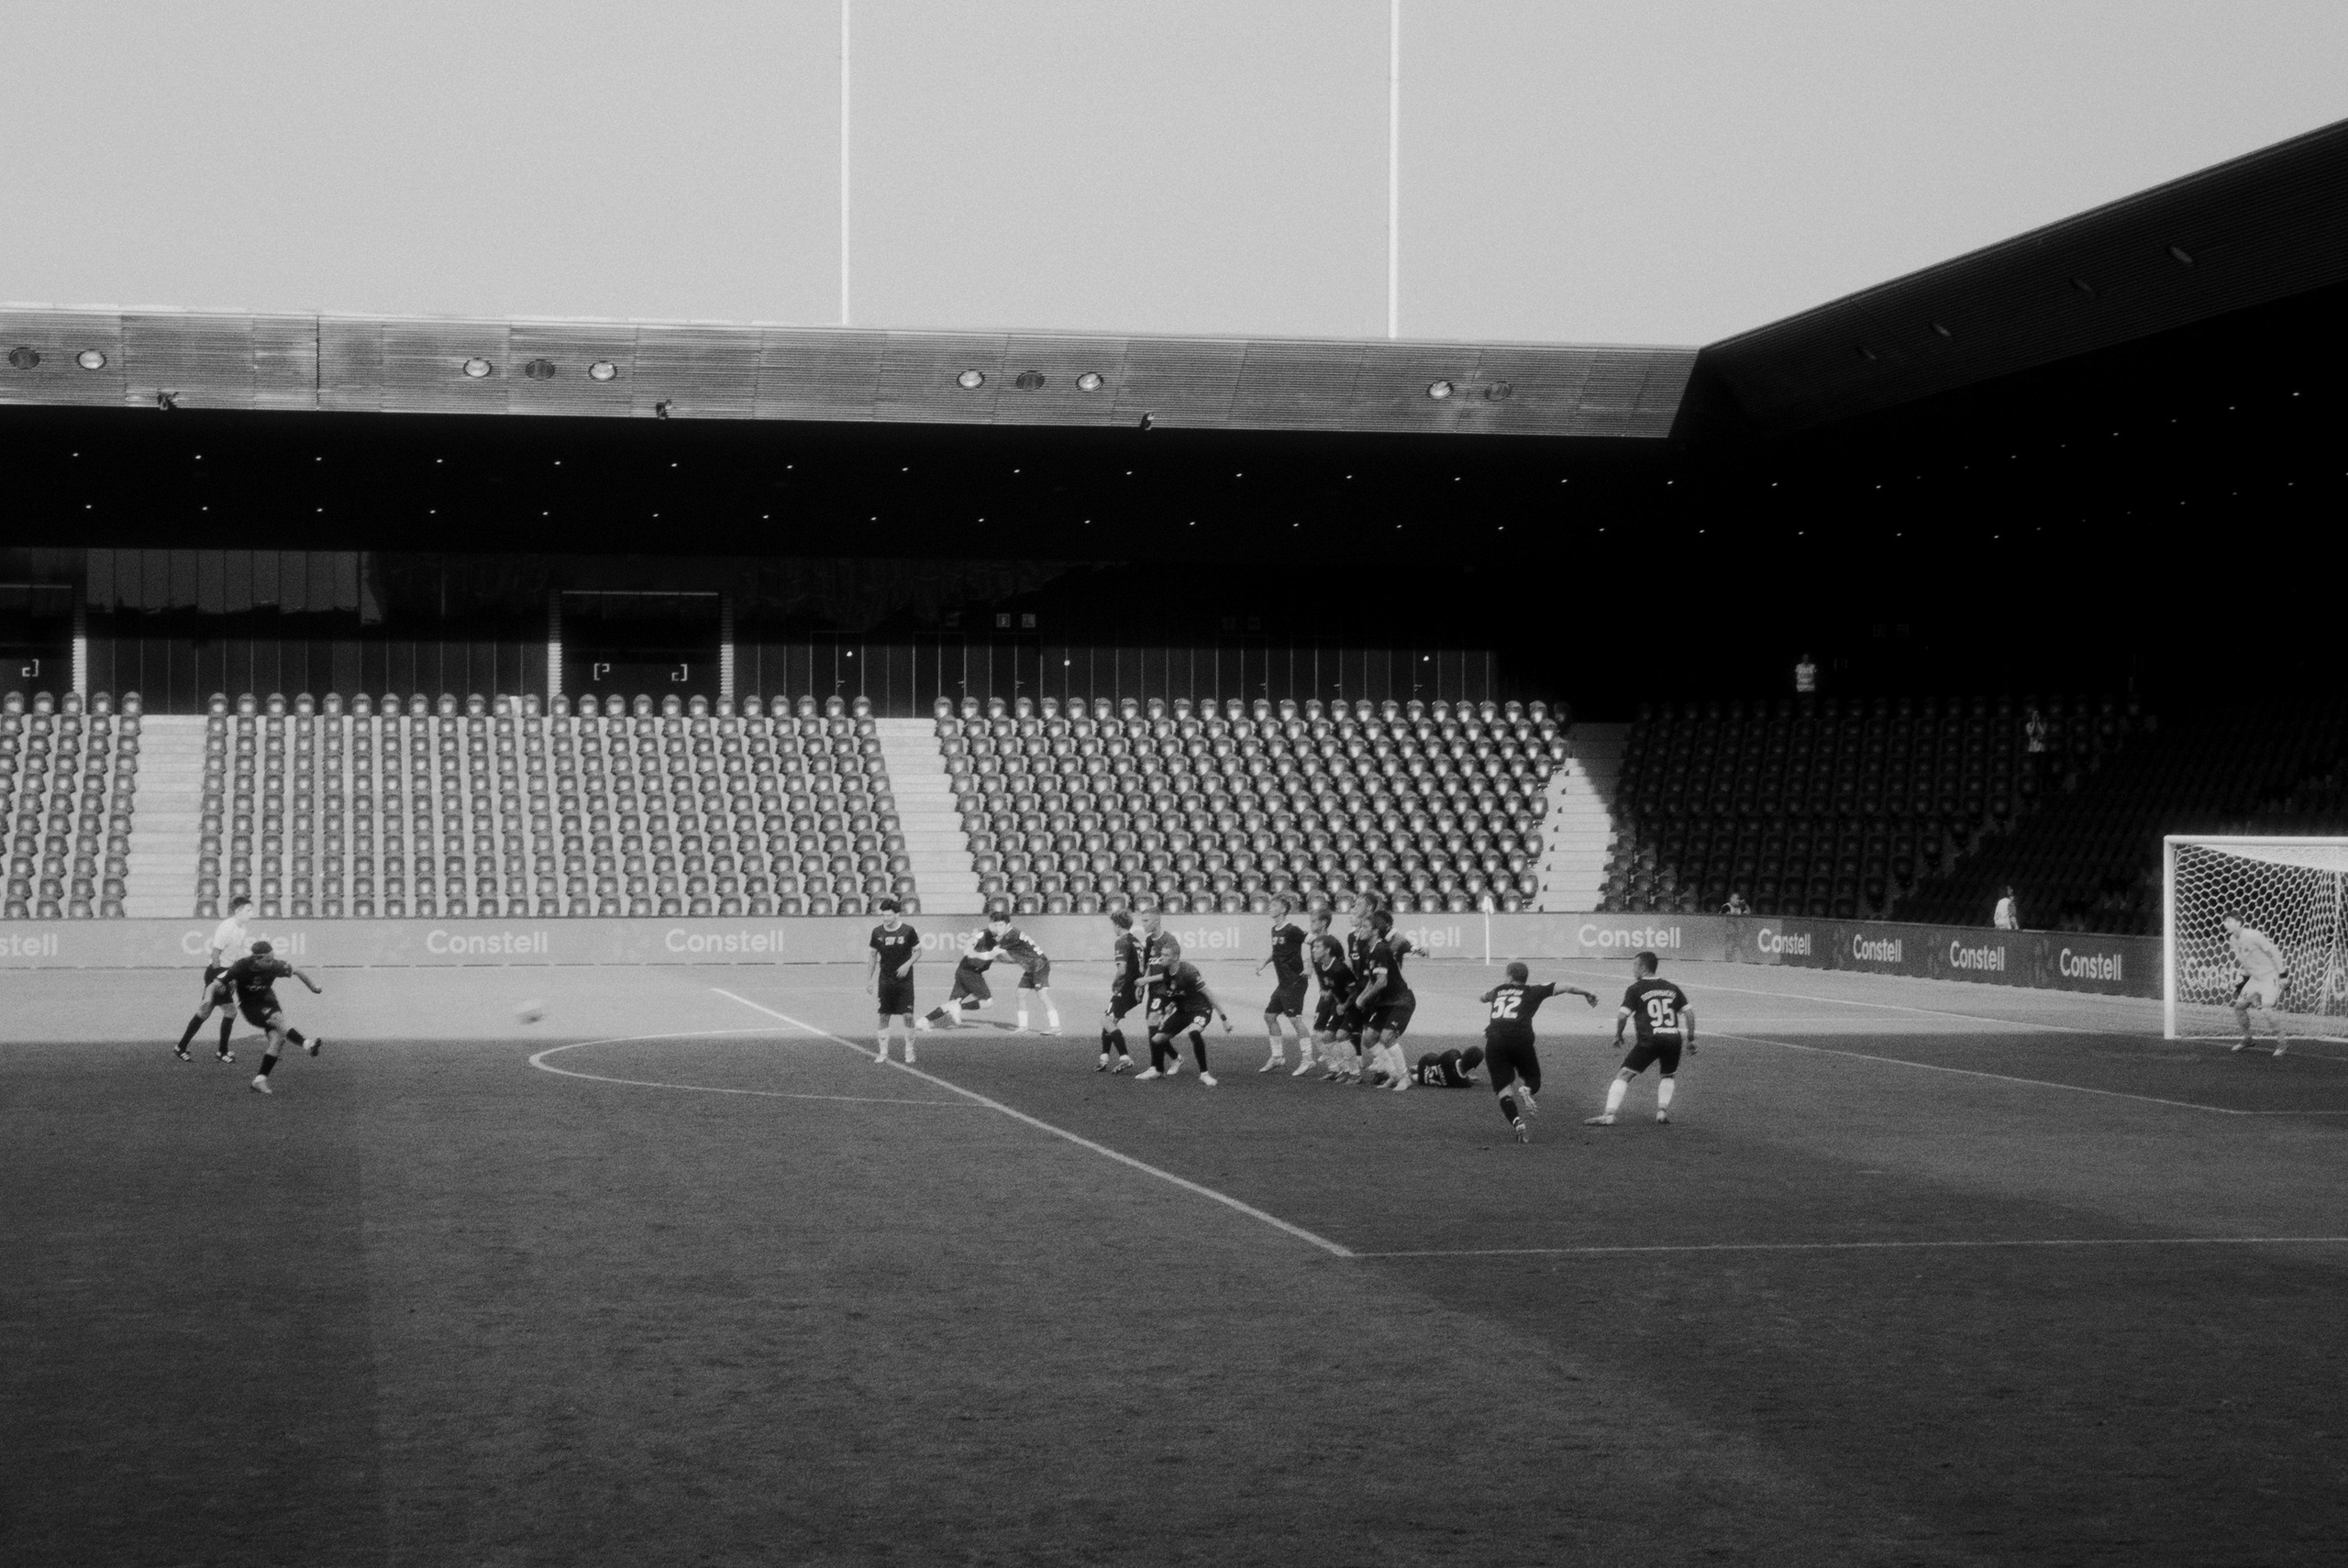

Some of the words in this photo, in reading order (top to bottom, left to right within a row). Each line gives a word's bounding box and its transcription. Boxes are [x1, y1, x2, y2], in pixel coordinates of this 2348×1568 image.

[0, 933, 58, 956] stell
[426, 929, 548, 955] Constell
[666, 928, 783, 953] Constell
[1405, 926, 1461, 947] stell
[1578, 923, 1680, 948] Constell
[1757, 928, 1811, 955] Constell
[1853, 933, 1901, 963] Constell
[1950, 940, 2005, 971] Constell
[2060, 947, 2122, 980] Constell
[1491, 996, 1522, 1019] 52
[1647, 998, 1676, 1027] 95
